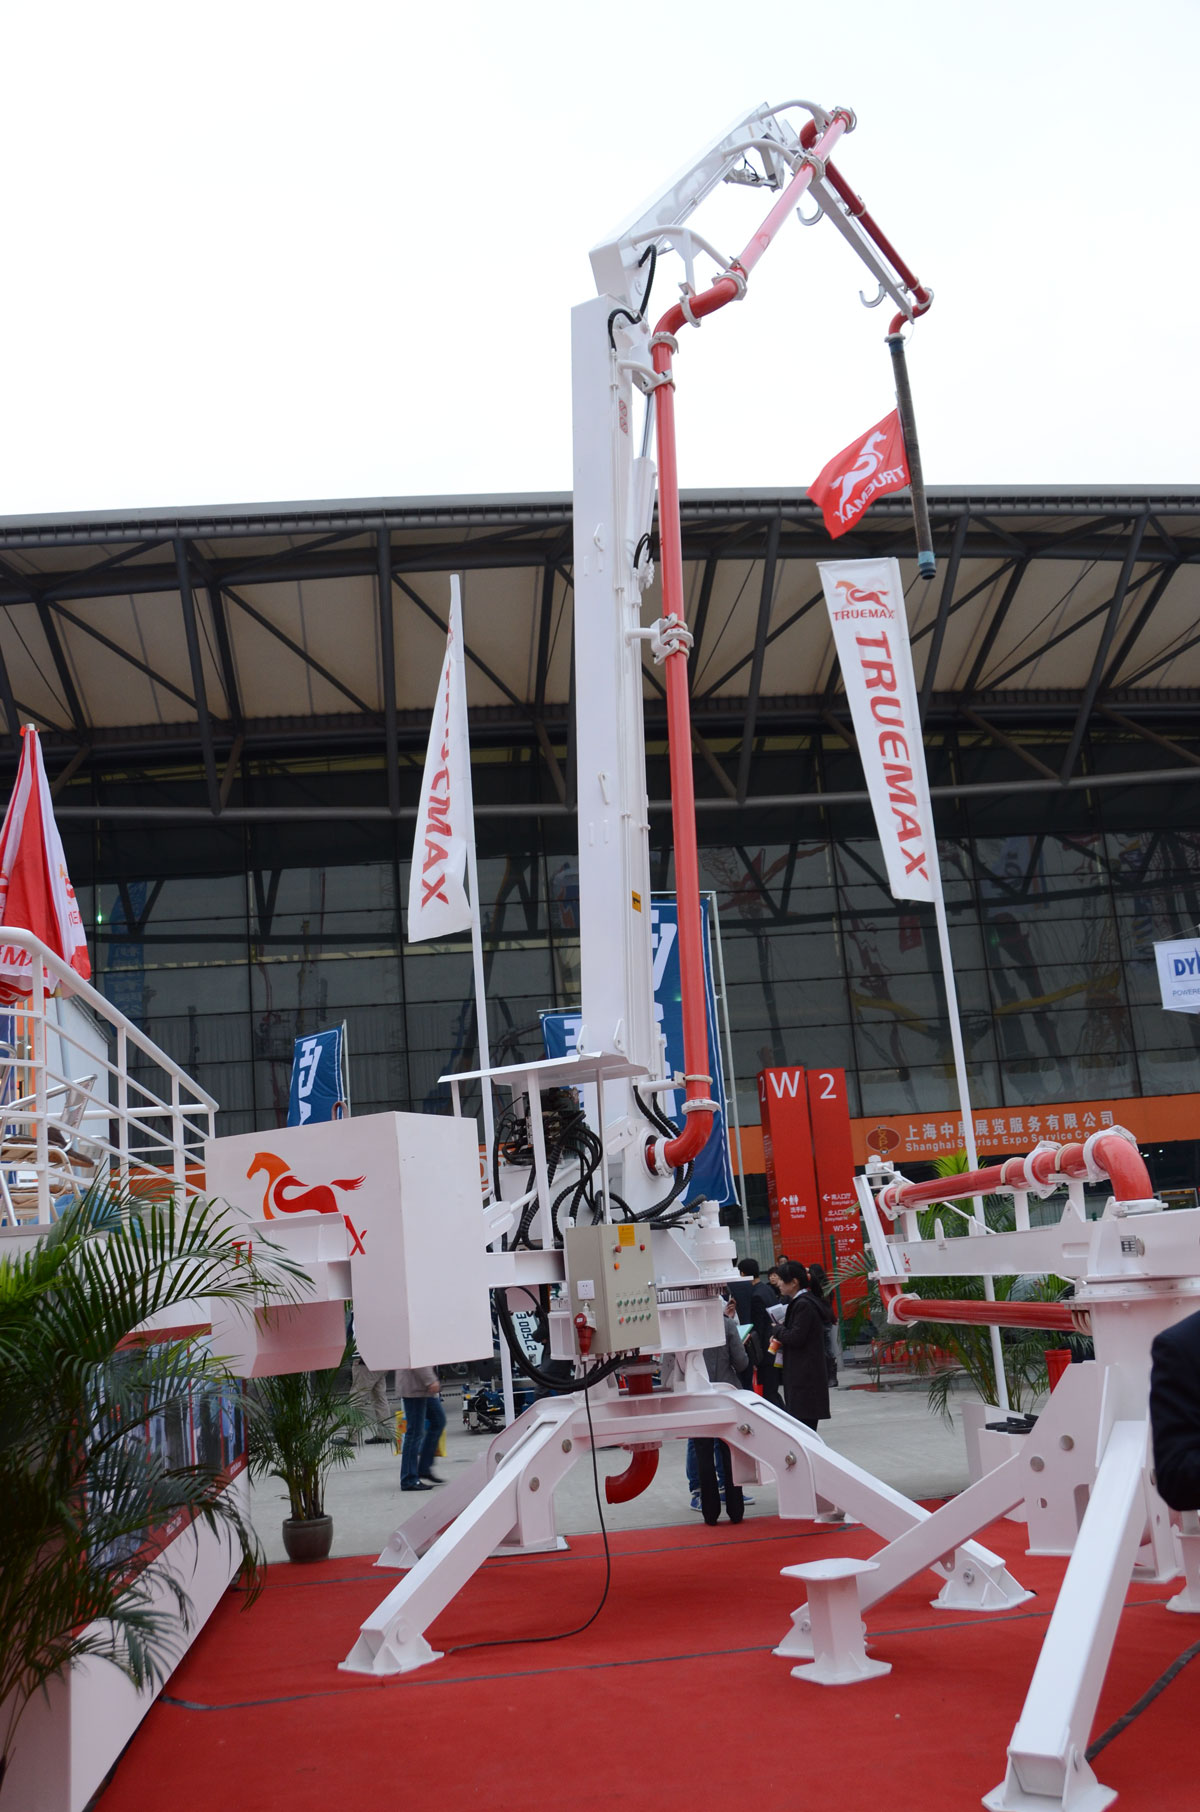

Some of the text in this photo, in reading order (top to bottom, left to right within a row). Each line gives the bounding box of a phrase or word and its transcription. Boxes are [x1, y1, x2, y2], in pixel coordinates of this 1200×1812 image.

[832, 608, 895, 621] TRUEMAX
[855, 630, 929, 881] TRUEMAX
[769, 1071, 837, 1099] W 2
[905, 1139, 955, 1152] Shanghai
[957, 1138, 999, 1148] Srise
[1002, 1136, 1028, 1146] Expo
[1031, 1131, 1072, 1142] Service
